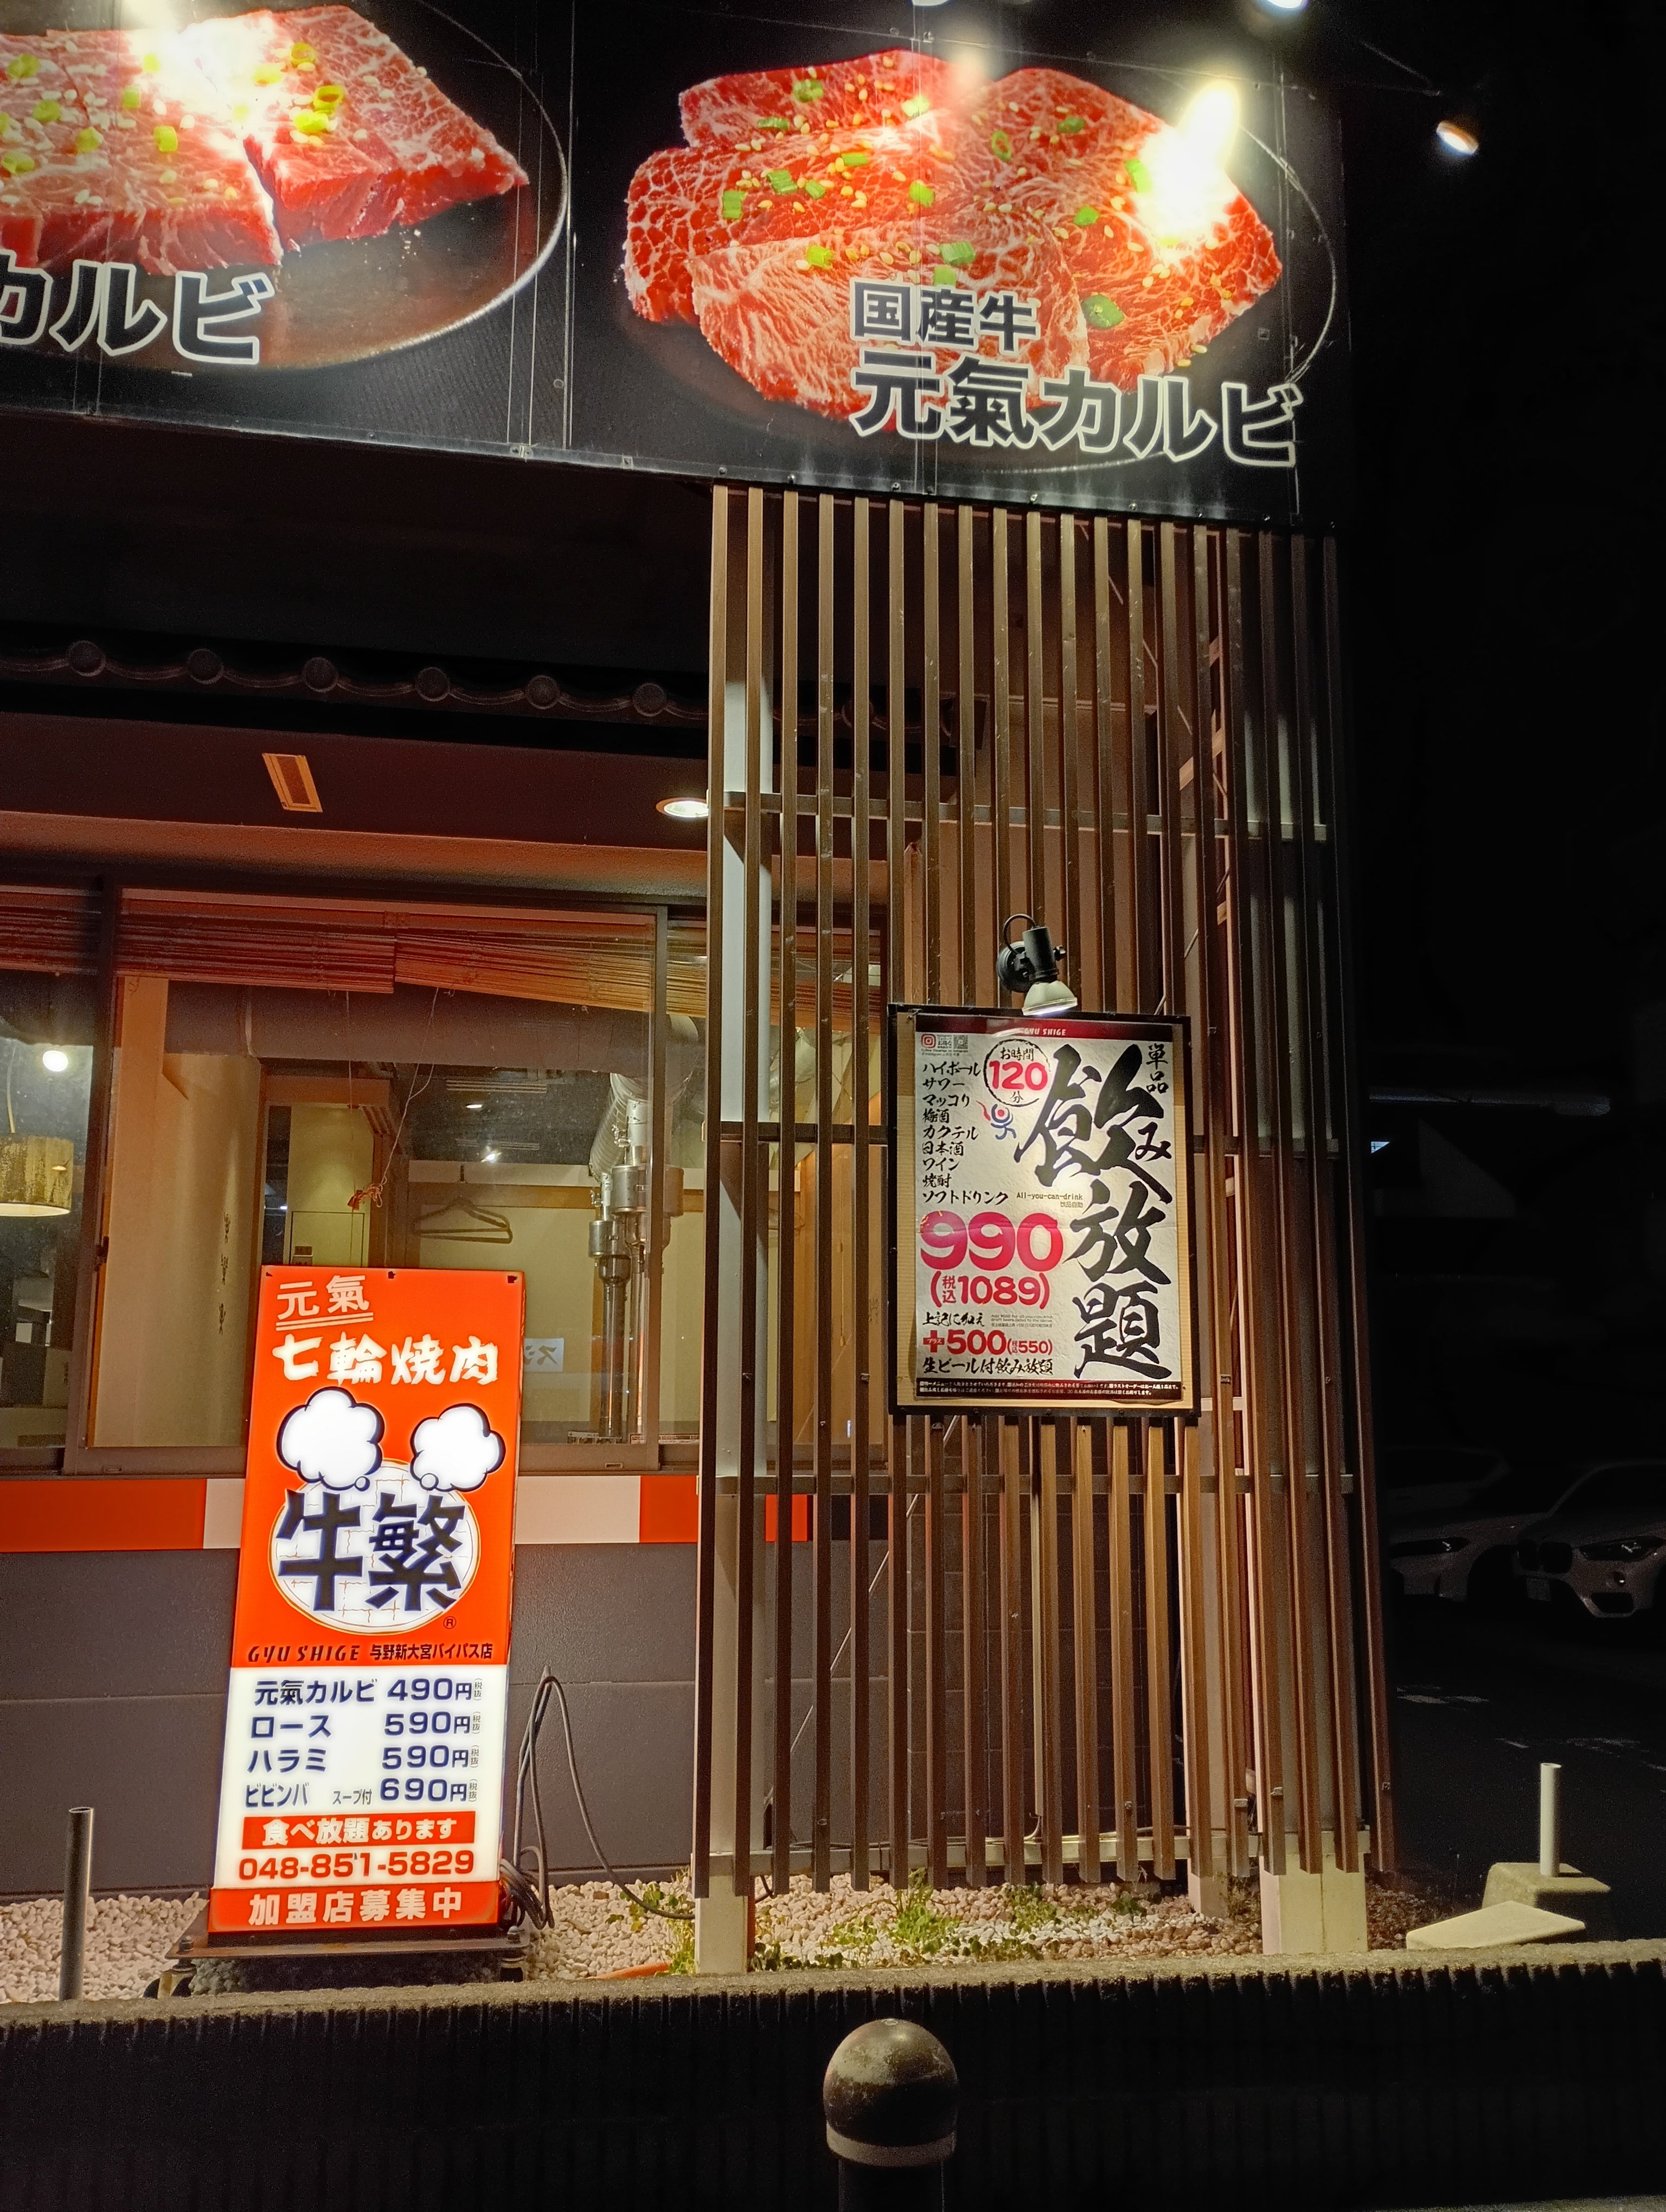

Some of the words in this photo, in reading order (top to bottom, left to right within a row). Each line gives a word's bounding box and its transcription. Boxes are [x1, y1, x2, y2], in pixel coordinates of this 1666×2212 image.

[850, 277, 1040, 352] 国産牛
[850, 349, 1303, 467] 元氣カルビ
[1001, 1046, 1034, 1061] お時間
[923, 1061, 981, 1077] ハイボール
[989, 1060, 1048, 1090] 120
[1145, 1044, 1169, 1094] 単品
[922, 1079, 965, 1091] サワー
[1010, 1091, 1023, 1103] 分
[922, 1094, 970, 1108] マッコリ
[922, 1108, 950, 1124] 梅酒
[923, 1124, 979, 1140] カクテル
[922, 1141, 964, 1156] 日本酒
[922, 1156, 959, 1171] ワイン
[922, 1173, 952, 1188] 焼酎
[922, 1191, 1009, 1205] ソフトドリンク
[1014, 1044, 1172, 1379] 飲み放題
[920, 1210, 1063, 1272] 990
[277, 1275, 369, 1320] 元氣
[922, 1311, 985, 1327] 上記に加え
[272, 1332, 498, 1386] 七輪焼肉
[923, 1356, 1053, 1375] 生ビール付飲み放題
[275, 1489, 465, 1611] 牛繁
[248, 1645, 291, 1663] GYU
[297, 1645, 360, 1661] SHIGE
[369, 1643, 493, 1660] 与野新大宮バイパス店
[254, 1679, 377, 1706] 元氣カルビ
[387, 1678, 473, 1701] 490円
[251, 1715, 331, 1738] ロース
[384, 1711, 470, 1735] 590円
[247, 1748, 326, 1772] ハラミ
[382, 1745, 469, 1770] 590円
[246, 1782, 310, 1808] ビビンバ
[332, 1788, 372, 1805] スープ付
[380, 1778, 467, 1803] 690円
[262, 1817, 457, 1846] 食べ放題あります
[239, 1850, 474, 1880] 048-851-5829
[248, 1887, 462, 1926] 加盟店募集中
